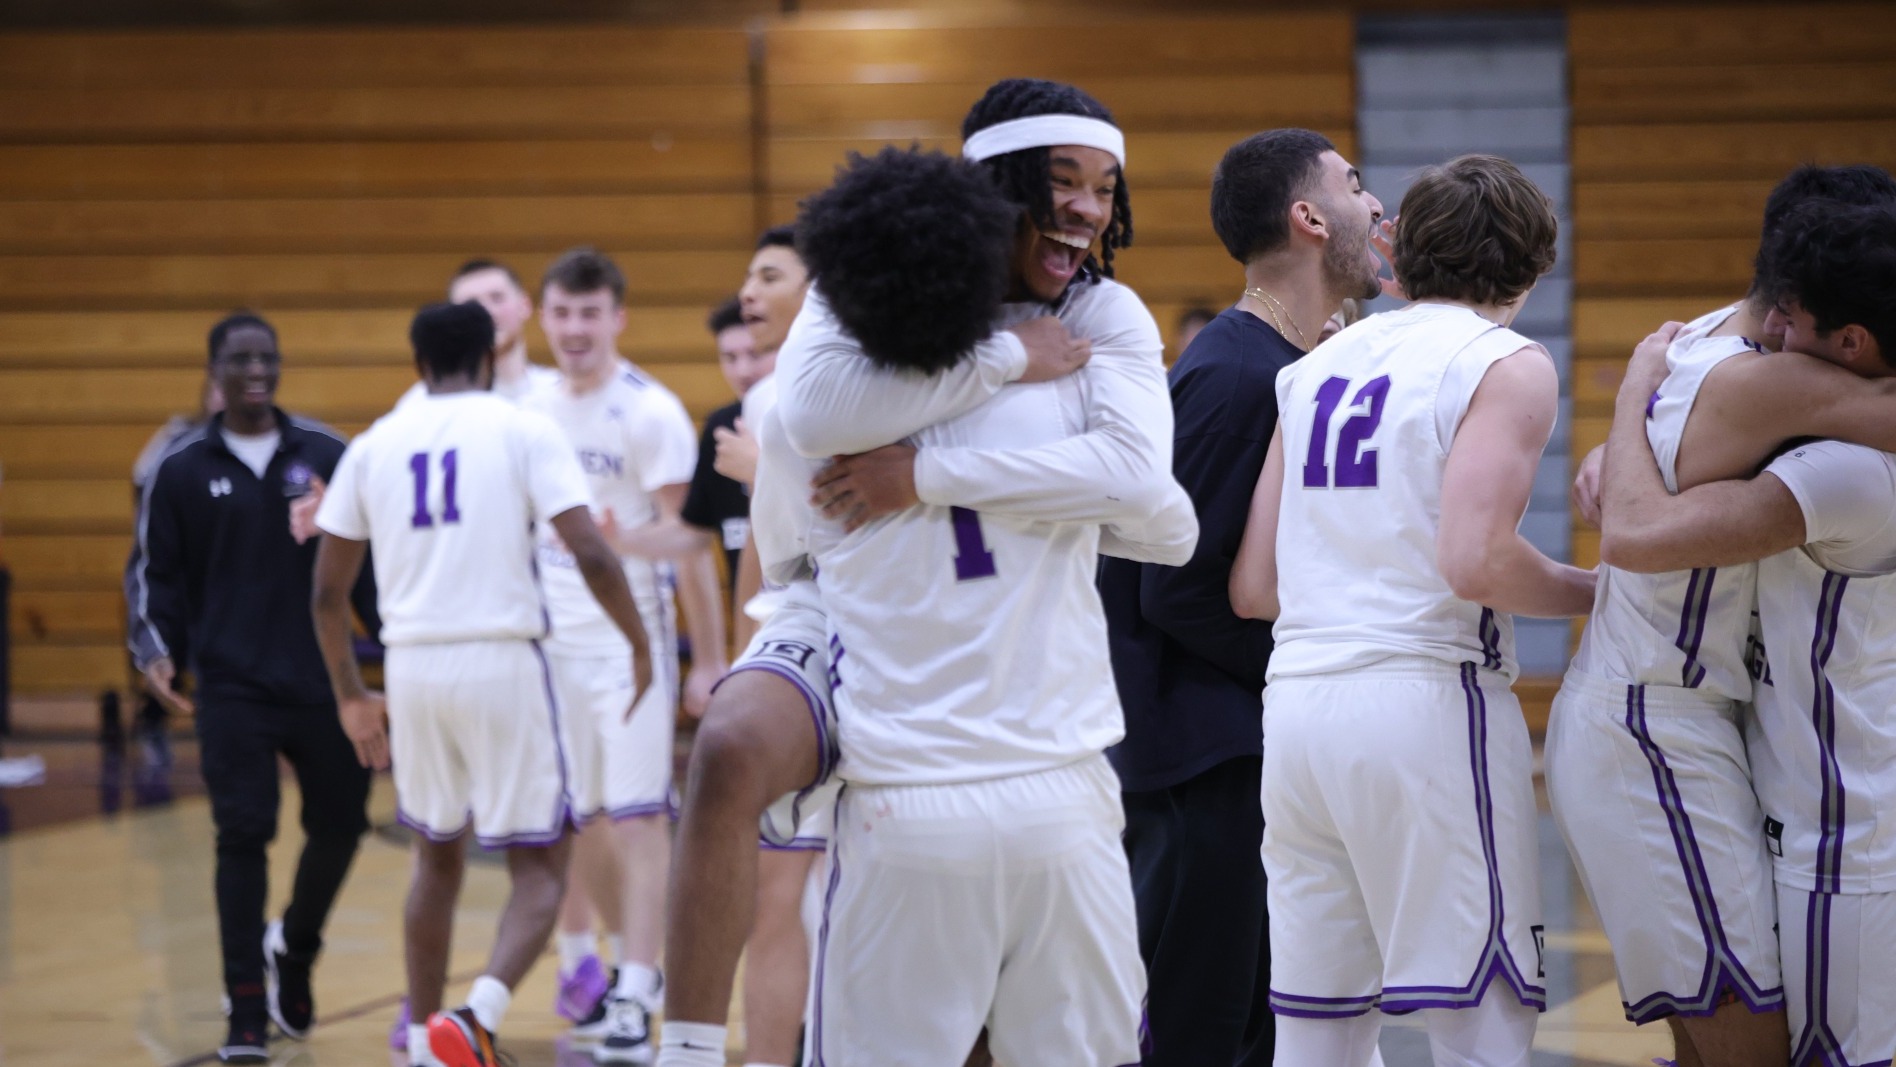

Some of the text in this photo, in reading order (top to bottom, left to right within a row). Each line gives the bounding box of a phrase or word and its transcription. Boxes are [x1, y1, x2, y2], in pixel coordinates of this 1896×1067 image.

[1302, 373, 1392, 490] 12
[409, 448, 461, 528] 11
[949, 505, 997, 582] 1
